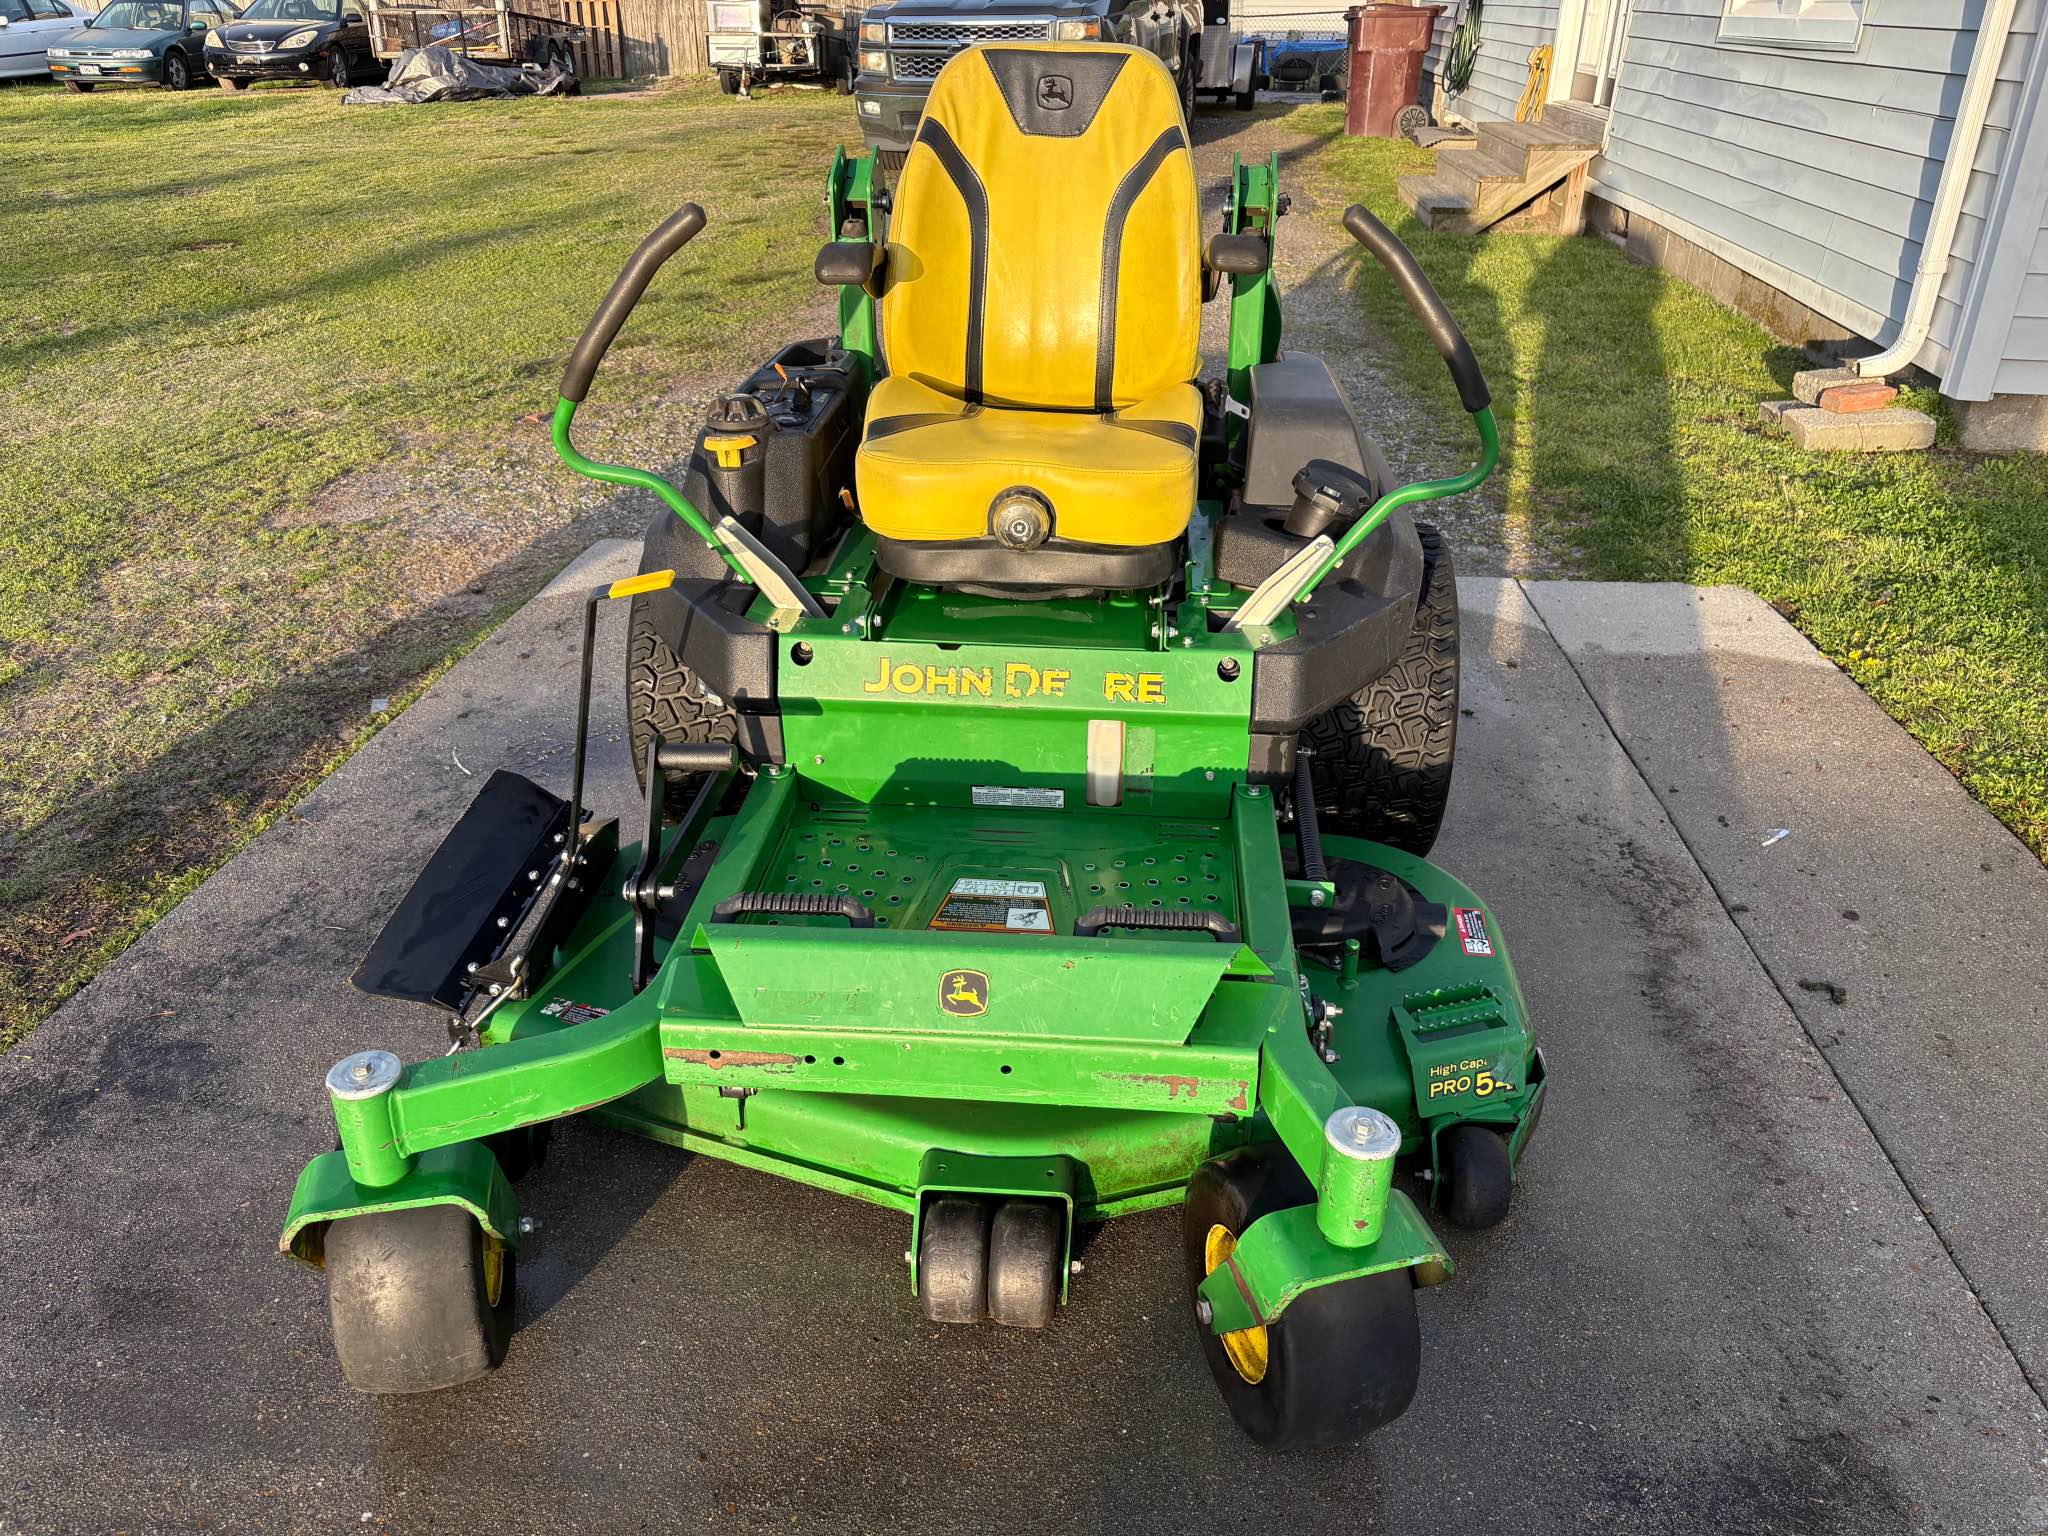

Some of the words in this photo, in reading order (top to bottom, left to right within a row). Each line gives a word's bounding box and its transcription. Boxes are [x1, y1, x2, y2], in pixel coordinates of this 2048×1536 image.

[864, 657, 993, 696] JOHN
[1005, 662, 1167, 703] DERE
[1430, 1063, 1457, 1077] High
[1430, 1076, 1471, 1098] PRO
